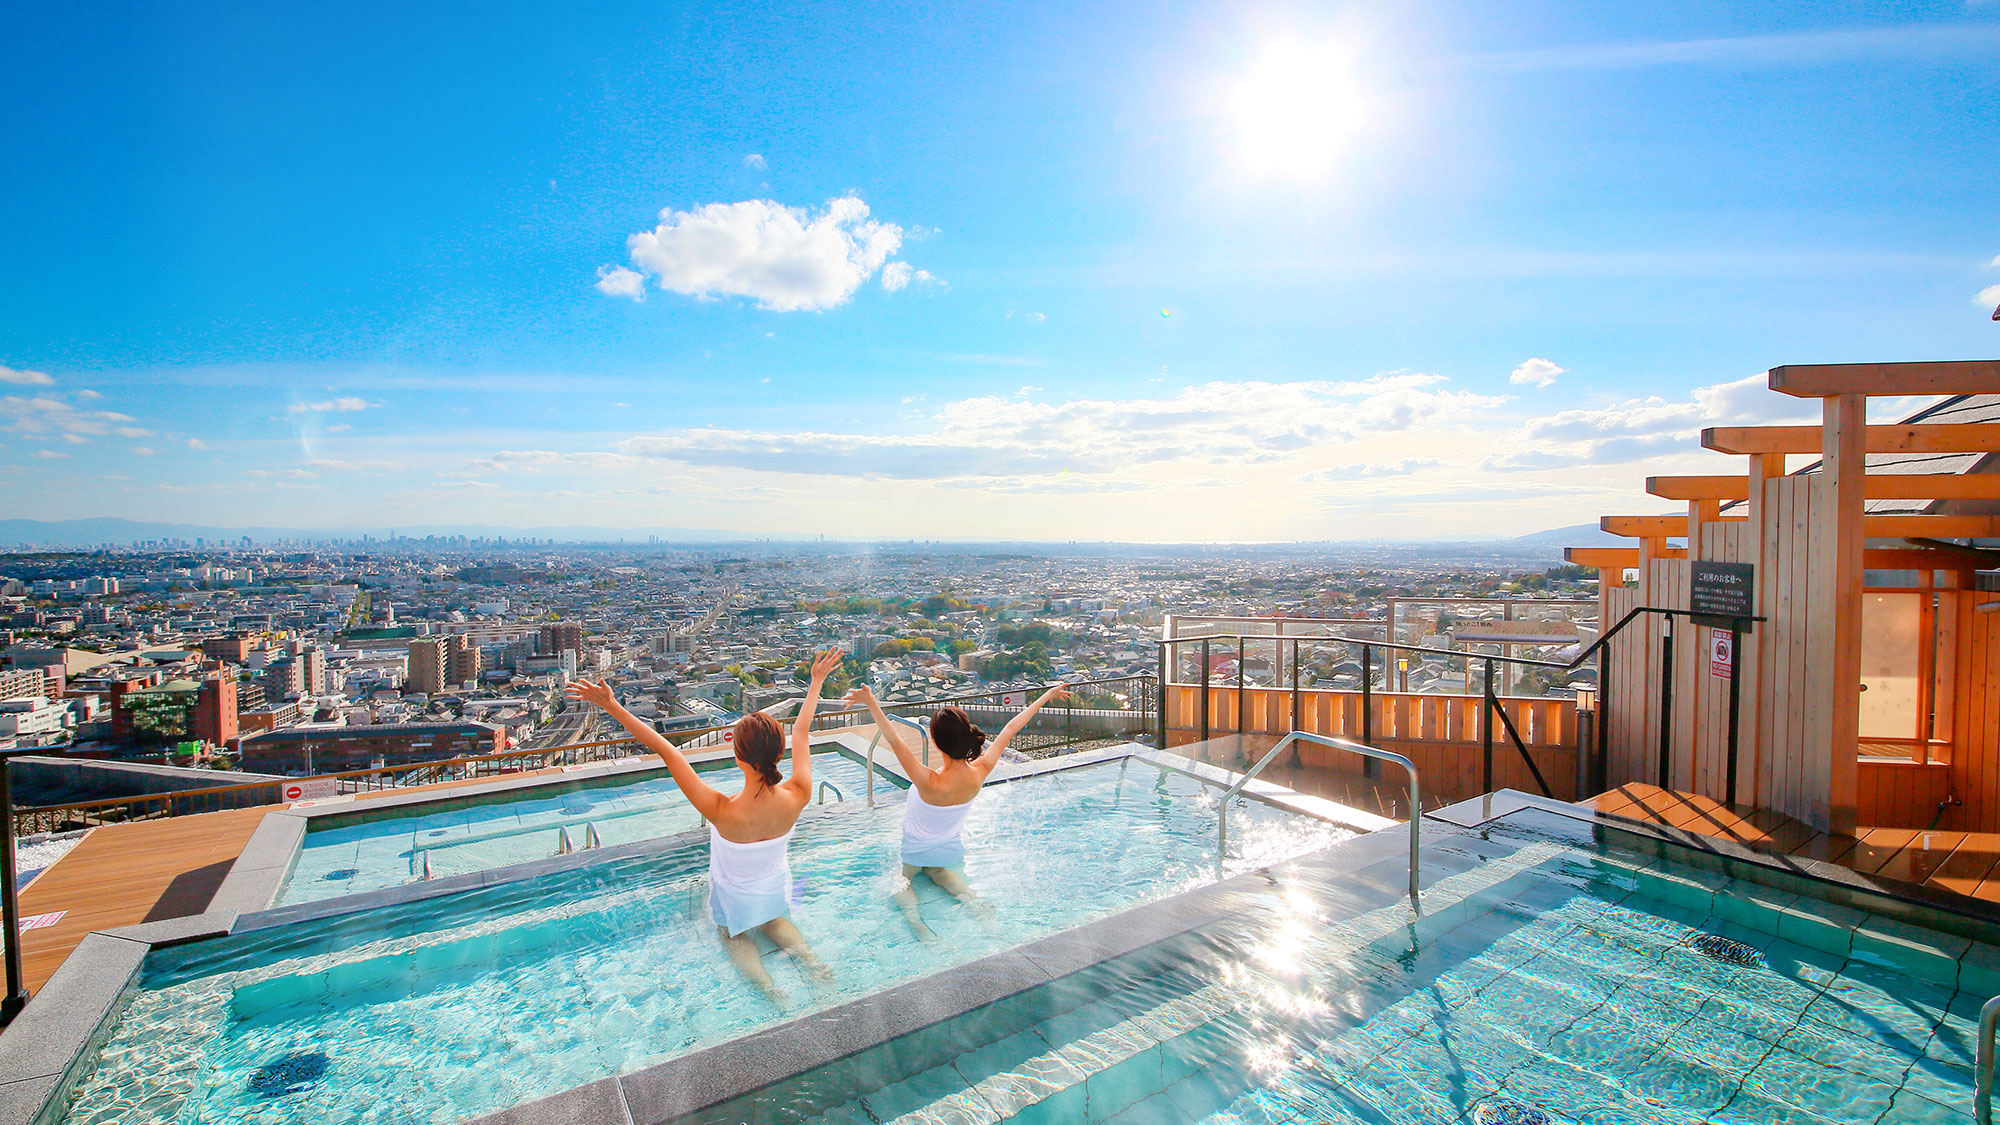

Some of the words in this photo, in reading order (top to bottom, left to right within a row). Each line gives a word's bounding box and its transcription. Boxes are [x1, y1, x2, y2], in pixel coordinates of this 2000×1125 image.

[1699, 572, 1742, 583] ご利用のお客様へ
